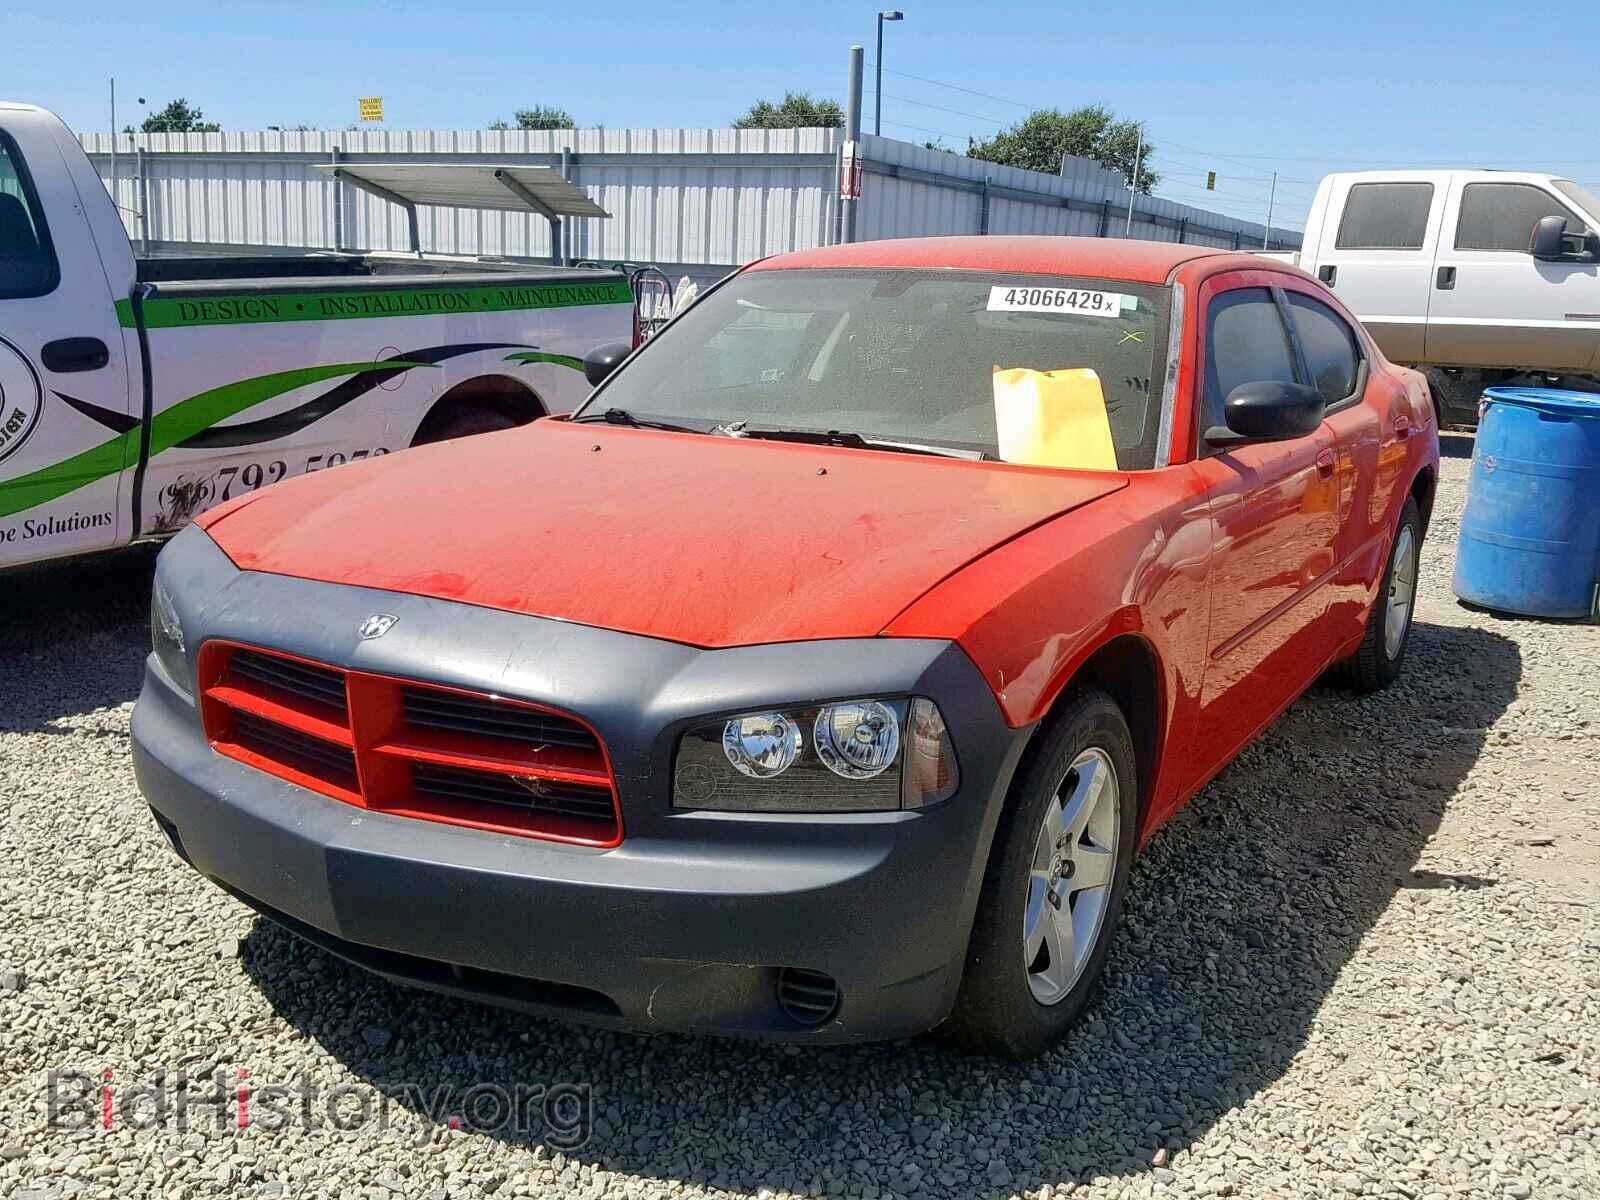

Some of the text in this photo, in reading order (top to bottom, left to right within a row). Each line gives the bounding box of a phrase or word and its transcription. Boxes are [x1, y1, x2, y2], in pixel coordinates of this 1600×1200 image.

[177, 285, 617, 321] DESIGN INSTALLATION MAINTENANCE
[23, 512, 112, 540] Solutions
